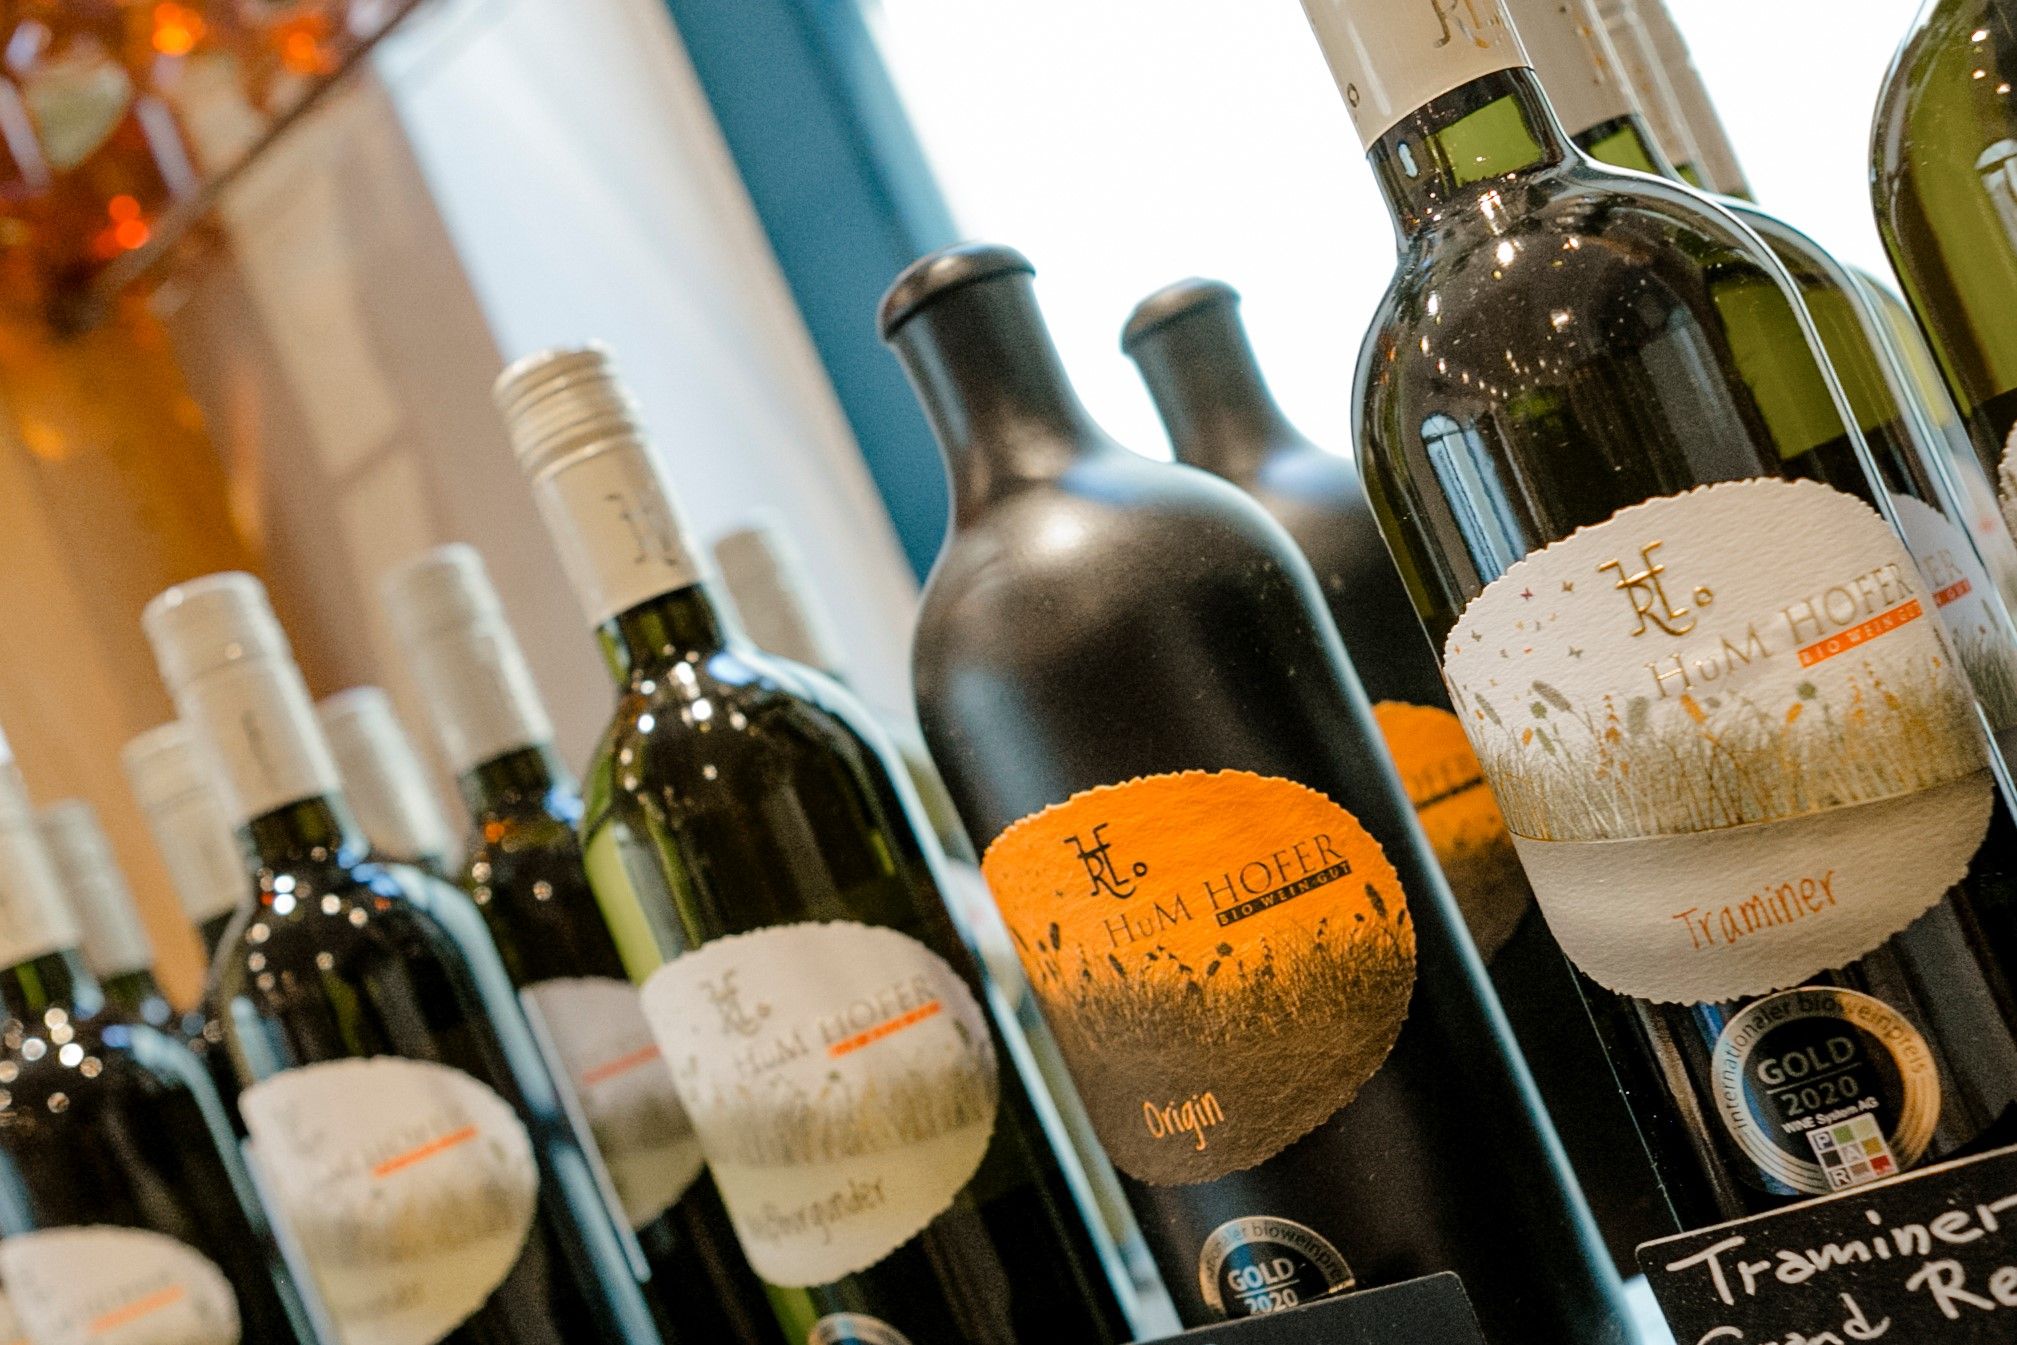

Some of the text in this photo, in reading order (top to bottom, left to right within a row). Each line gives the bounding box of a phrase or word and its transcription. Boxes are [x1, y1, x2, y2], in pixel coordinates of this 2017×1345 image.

[1645, 619, 1773, 699] HuM
[1781, 561, 1915, 646] HOFER
[1103, 892, 1195, 949] HuM
[1202, 833, 1343, 911] HOFER
[1218, 902, 1254, 927] BIO
[1672, 869, 1837, 949] Traminer
[1757, 1035, 1856, 1086] GOLD
[1143, 1091, 1225, 1151] Origin
[1780, 1075, 1860, 1117] 2020
[1227, 1257, 1295, 1292] GOLD
[1665, 1194, 2017, 1306] Traminer
[1243, 1288, 1299, 1314] 2020
